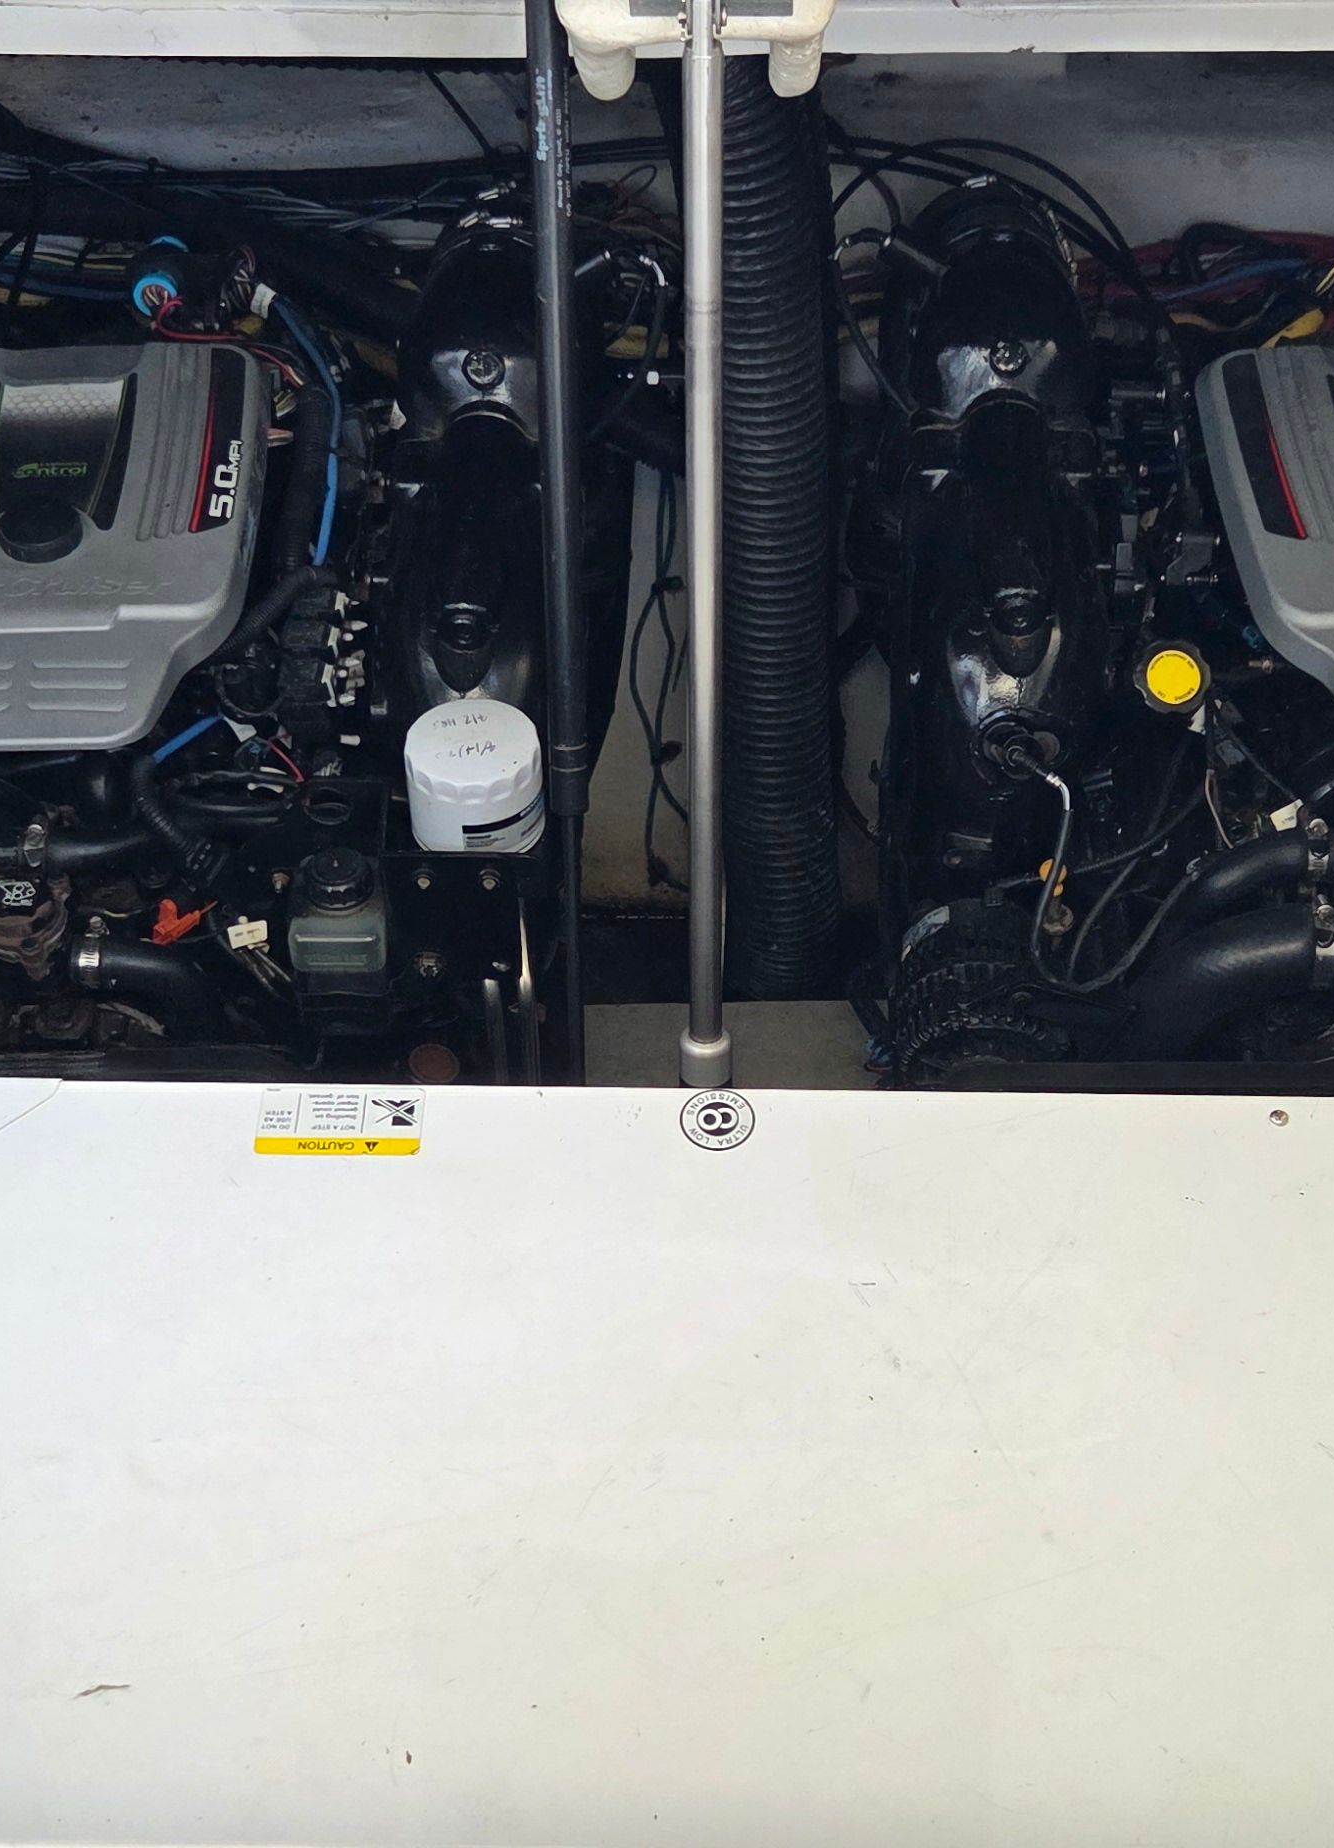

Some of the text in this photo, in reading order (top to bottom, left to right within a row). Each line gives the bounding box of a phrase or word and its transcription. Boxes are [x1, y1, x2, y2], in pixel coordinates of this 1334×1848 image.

[686, 1093, 748, 1146] ULTRA LOW EMISSIONS
[298, 1141, 355, 1150] CAUTION
